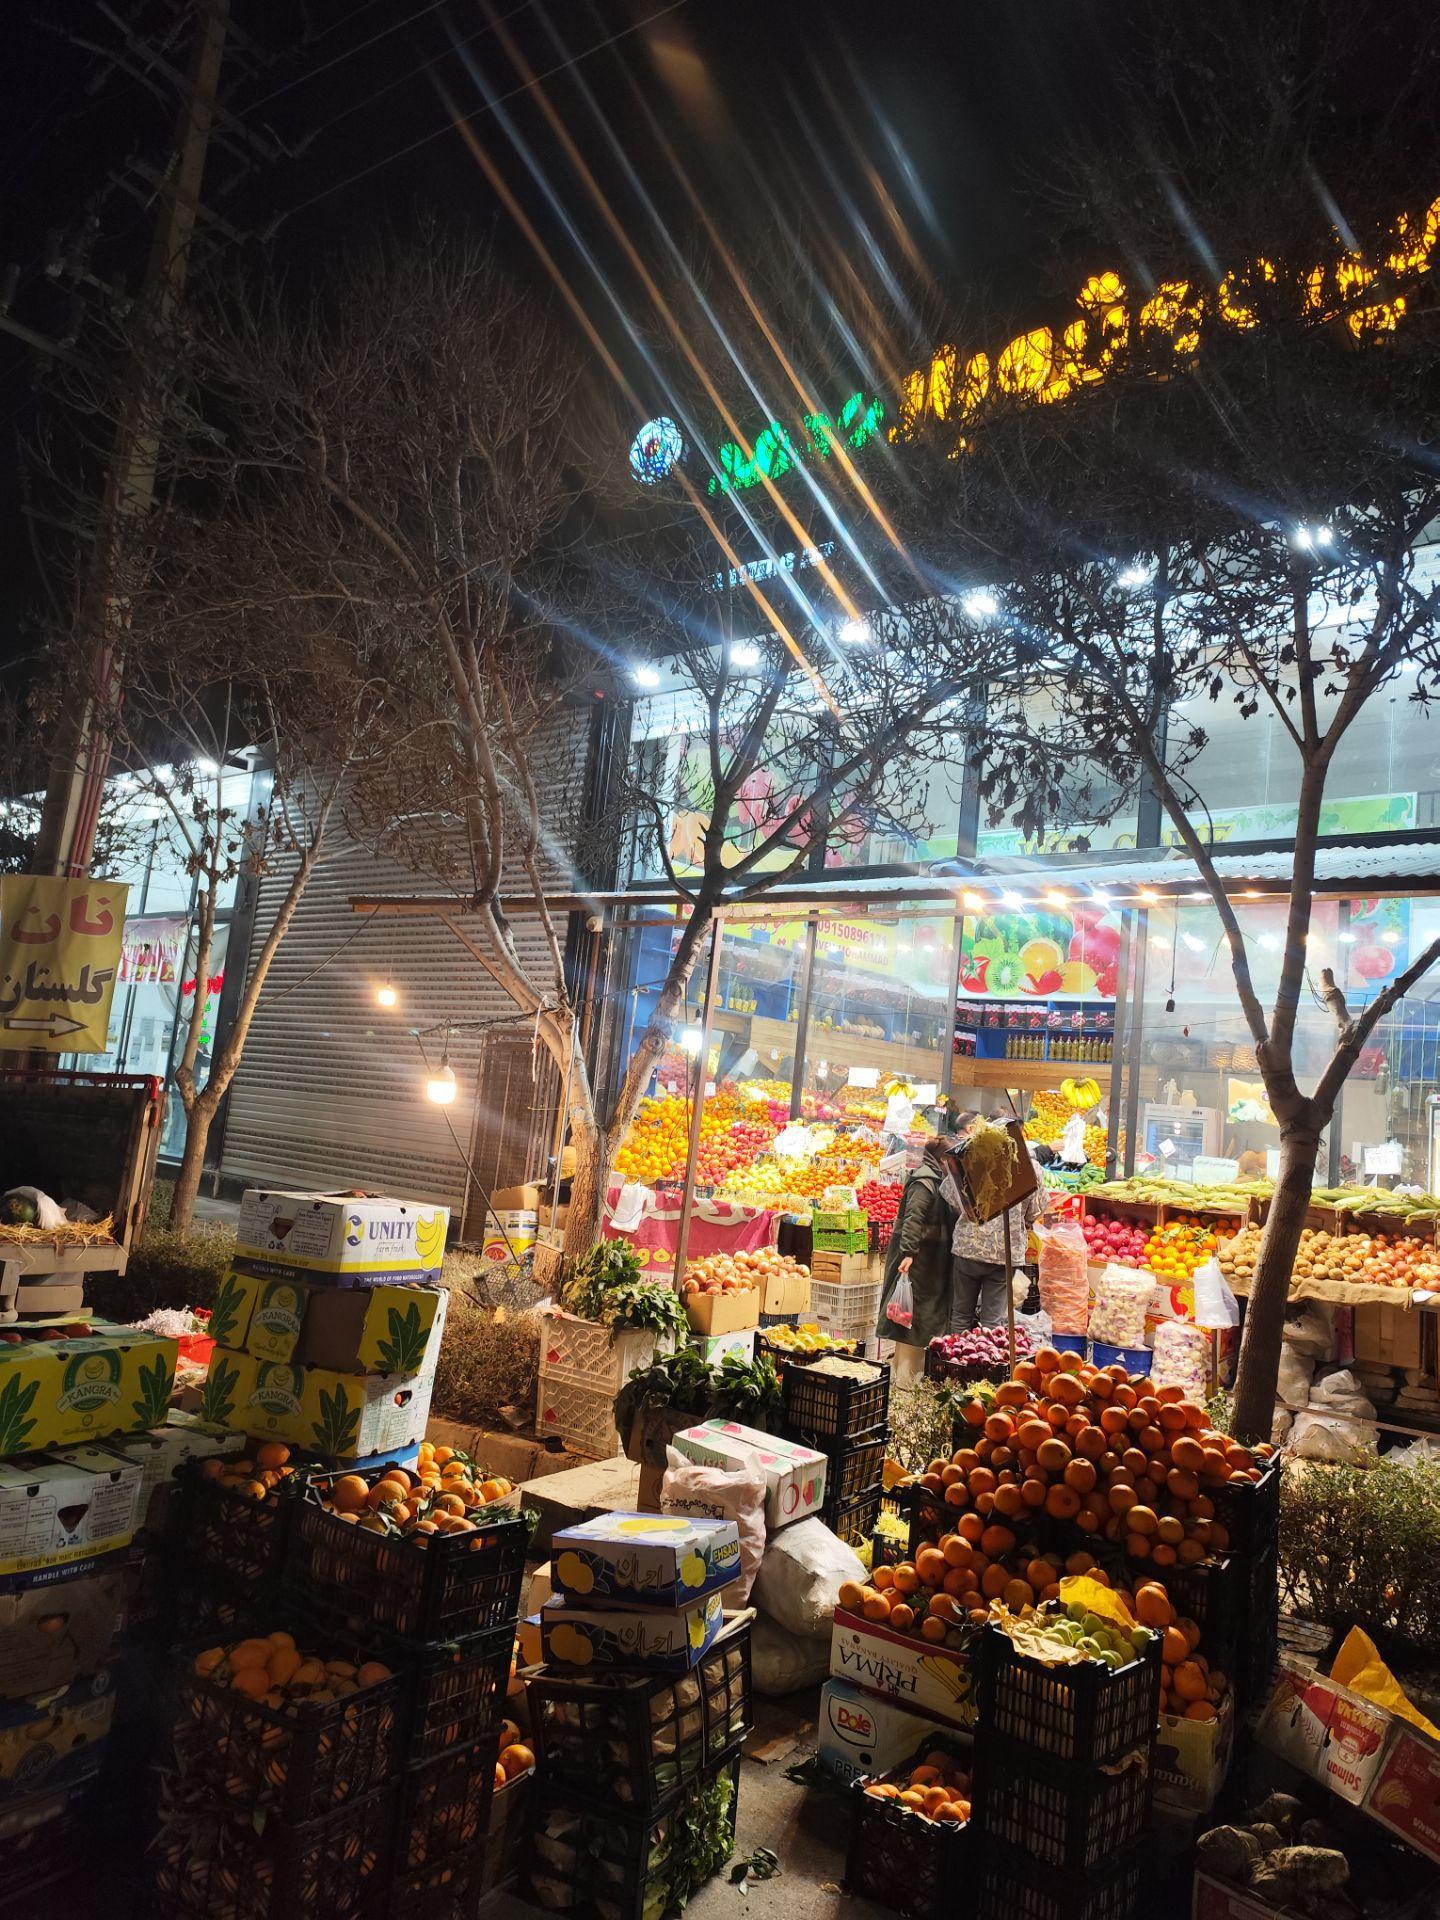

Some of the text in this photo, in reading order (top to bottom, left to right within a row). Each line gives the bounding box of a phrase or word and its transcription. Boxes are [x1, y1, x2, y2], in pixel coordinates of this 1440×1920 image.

[11, 894, 114, 945] نان
[0, 960, 114, 1013] گلستان
[369, 1221, 414, 1240] UNITY
[262, 1311, 297, 1330] KANGRA
[67, 1384, 113, 1403] KANGRA
[258, 1390, 294, 1408] KANGRA
[713, 1540, 739, 1562] EHSAN
[33, 1571, 59, 1583] HANDLE
[62, 1566, 78, 1576] WITH
[840, 1645, 918, 1694] PRIMA
[878, 1655, 918, 1675] QUALITY
[837, 1707, 872, 1733] Dole
[1326, 1759, 1362, 1791] Salman
